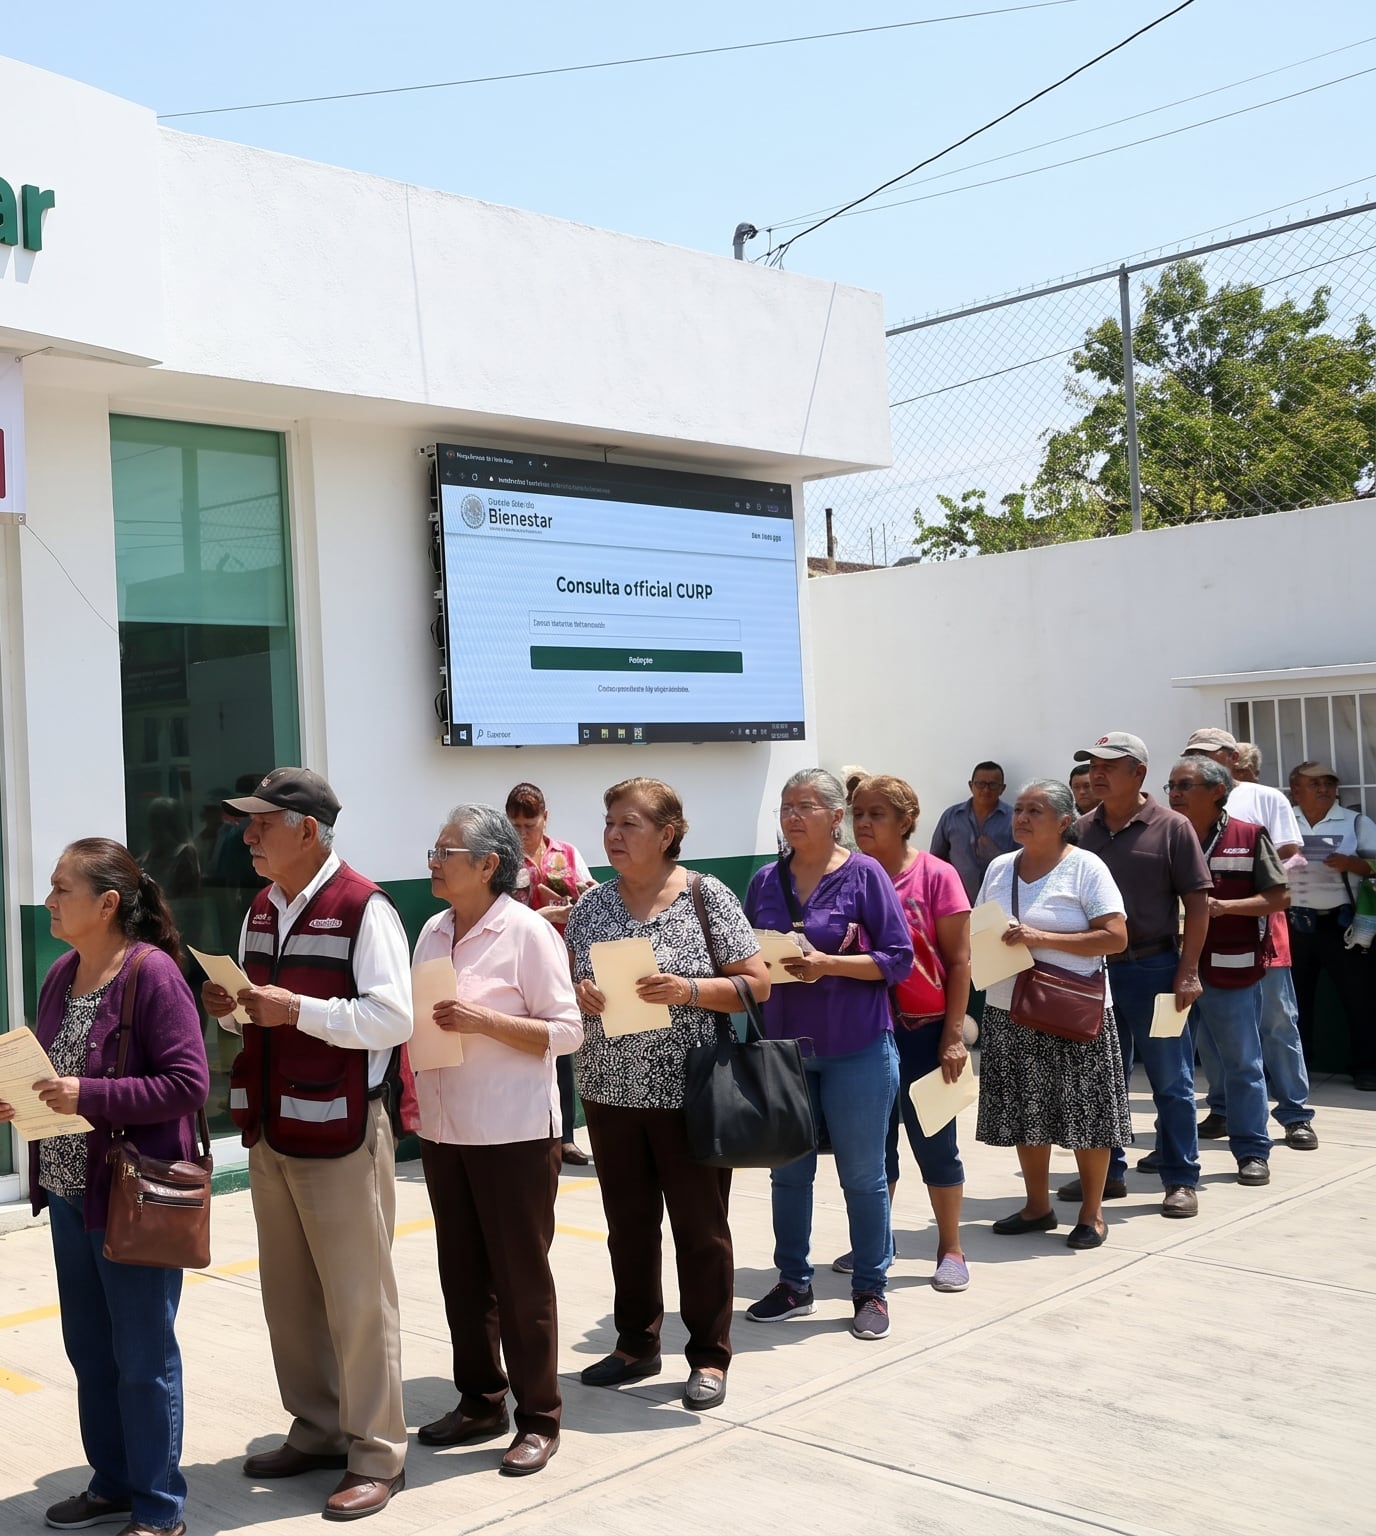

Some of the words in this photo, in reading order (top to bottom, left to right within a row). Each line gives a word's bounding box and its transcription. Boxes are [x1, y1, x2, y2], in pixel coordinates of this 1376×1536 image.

[489, 508, 552, 528] Bienestar
[556, 576, 620, 595] Consulta
[624, 580, 672, 598] official
[676, 583, 713, 600] CURP
